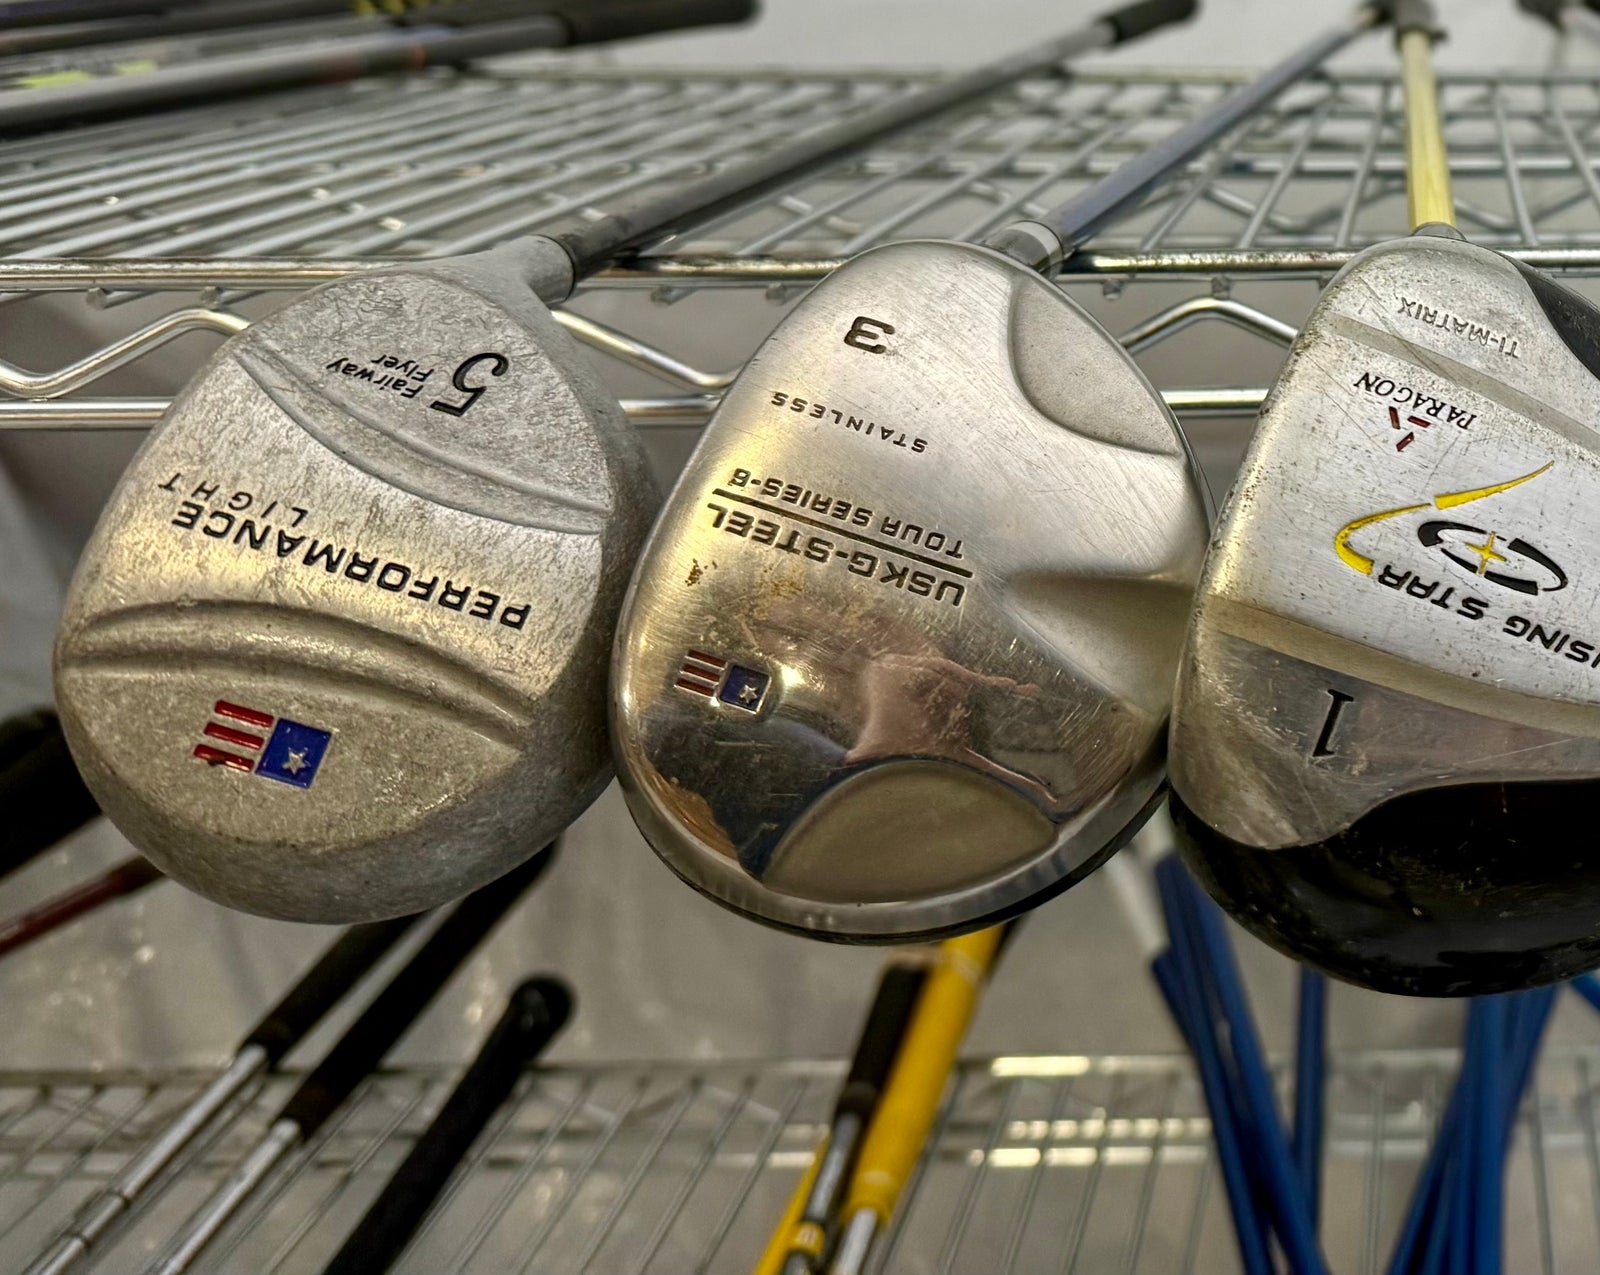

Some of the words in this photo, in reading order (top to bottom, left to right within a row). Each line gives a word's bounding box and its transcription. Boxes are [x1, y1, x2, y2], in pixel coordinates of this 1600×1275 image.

[844, 316, 896, 355] 3
[1398, 298, 1521, 360] TI-MATRIX
[327, 358, 424, 399] Fairway
[371, 352, 435, 383] Flyer
[431, 352, 509, 416] 5
[770, 391, 928, 453] STAINLESS
[1354, 371, 1478, 431] PARAGON
[158, 472, 309, 527] LIGHT
[730, 467, 875, 527] SERIES-6
[171, 500, 533, 631] PERFORMANCE
[706, 502, 966, 607] USKG-STEEL
[879, 515, 964, 560] TOUR
[1377, 563, 1489, 621] STAR
[1311, 688, 1354, 758] 1
